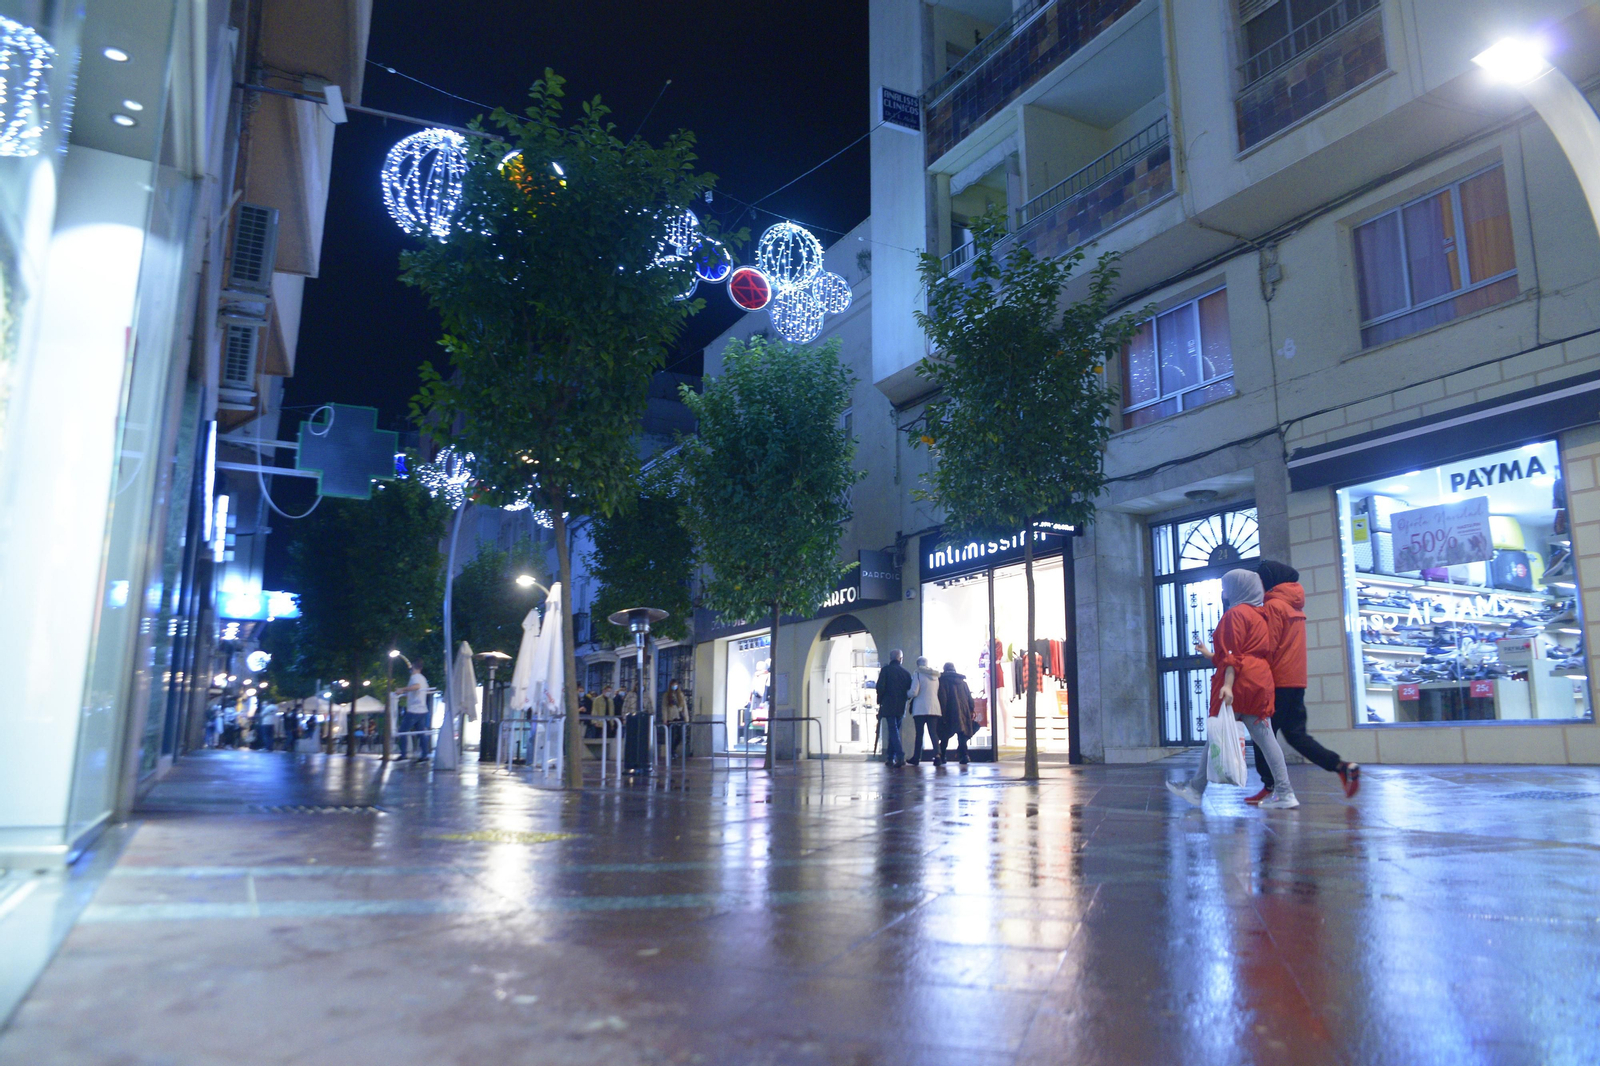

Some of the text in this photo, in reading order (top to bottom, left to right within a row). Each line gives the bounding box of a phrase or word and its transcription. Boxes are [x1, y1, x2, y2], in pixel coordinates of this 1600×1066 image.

[884, 90, 918, 107] ANALISIS
[1450, 456, 1546, 492] PAYMA
[1402, 527, 1458, 554] -50%
